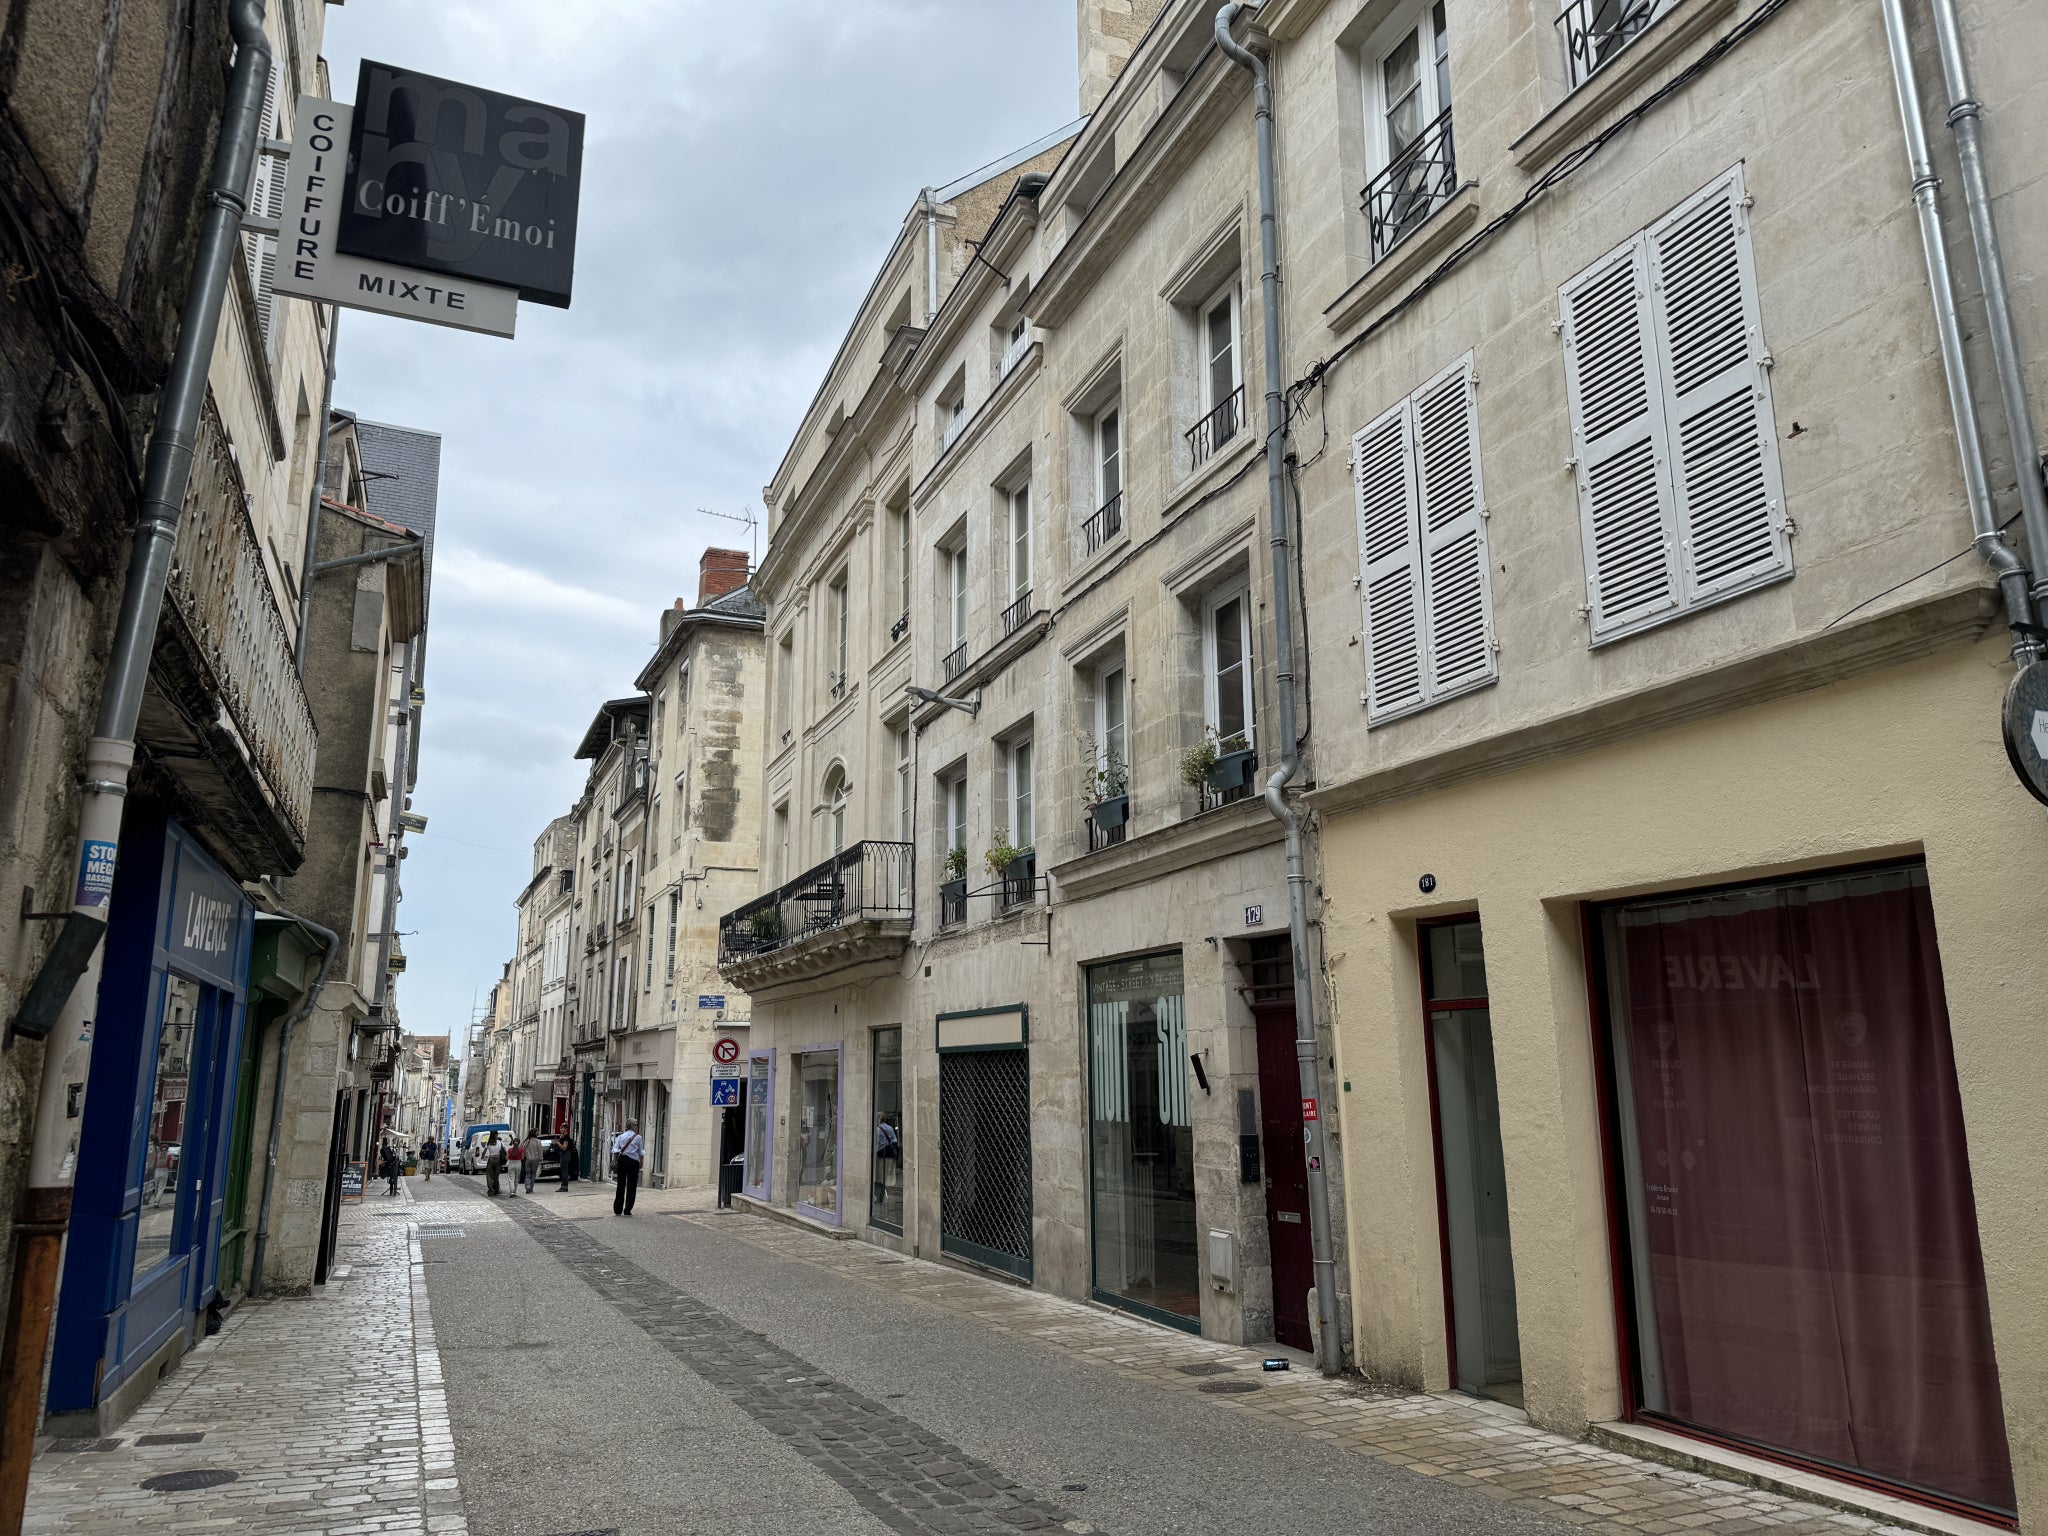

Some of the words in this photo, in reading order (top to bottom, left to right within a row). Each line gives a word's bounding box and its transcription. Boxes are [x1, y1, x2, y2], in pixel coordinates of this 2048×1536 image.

[294, 114, 335, 281] COIFFURE
[358, 179, 556, 250] Coiff'Émoi
[358, 273, 466, 311] MIXTE
[1421, 877, 1433, 888] 181
[183, 891, 232, 959] LAVERIE
[1246, 905, 1261, 924] 179
[1121, 975, 1143, 991] STREET
[1092, 1000, 1129, 1123] HUIT
[1156, 995, 1192, 1127] SIX
